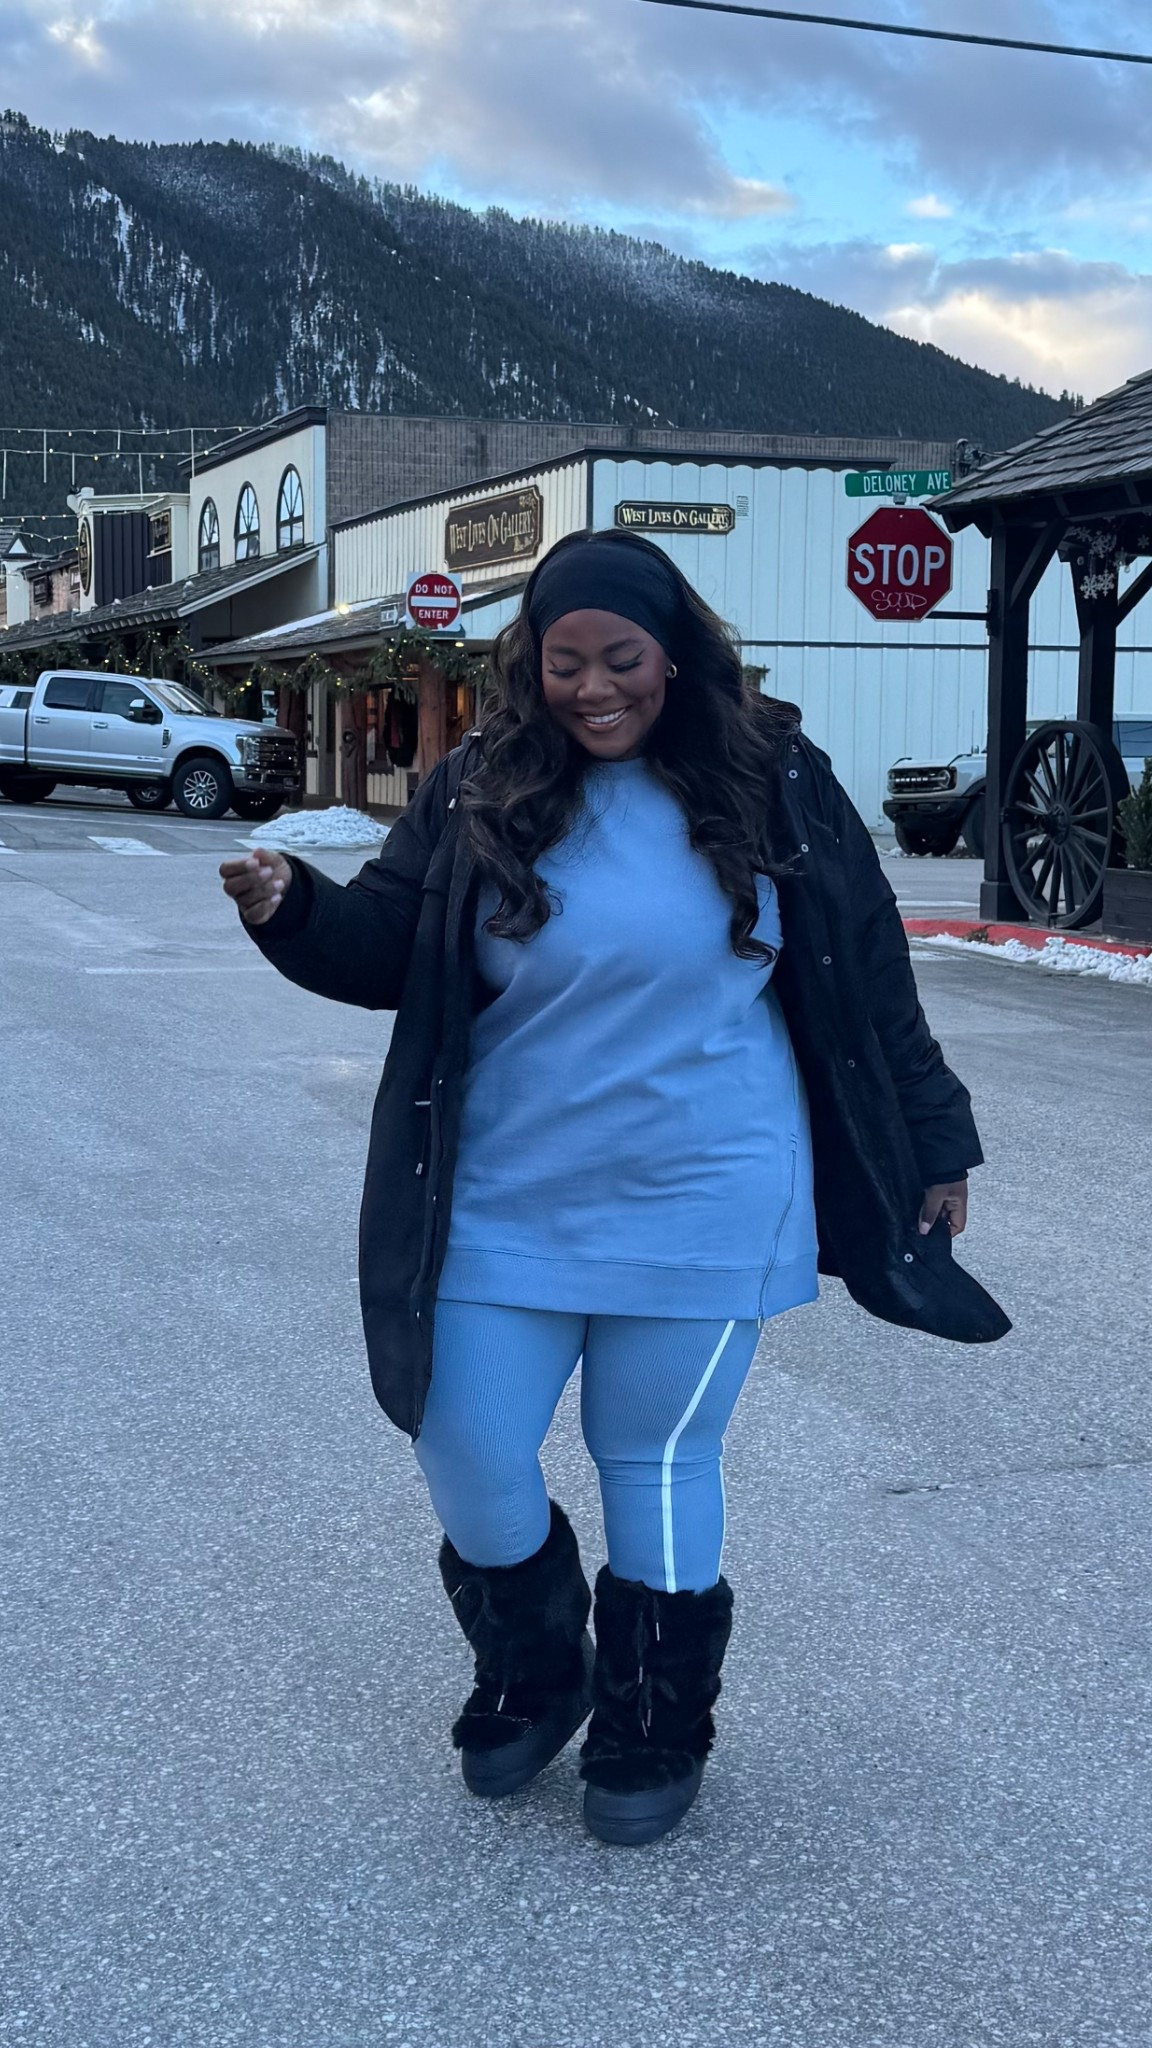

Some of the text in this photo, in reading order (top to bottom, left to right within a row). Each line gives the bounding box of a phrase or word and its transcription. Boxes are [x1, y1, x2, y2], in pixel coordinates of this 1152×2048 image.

[863, 472, 950, 493] DELONEY AVE
[622, 508, 646, 524] WEST
[648, 509, 671, 524] LIVES
[673, 509, 688, 525] ON
[853, 543, 945, 586] STOP
[415, 584, 453, 594] DO NOT
[418, 609, 449, 620] ENTER
